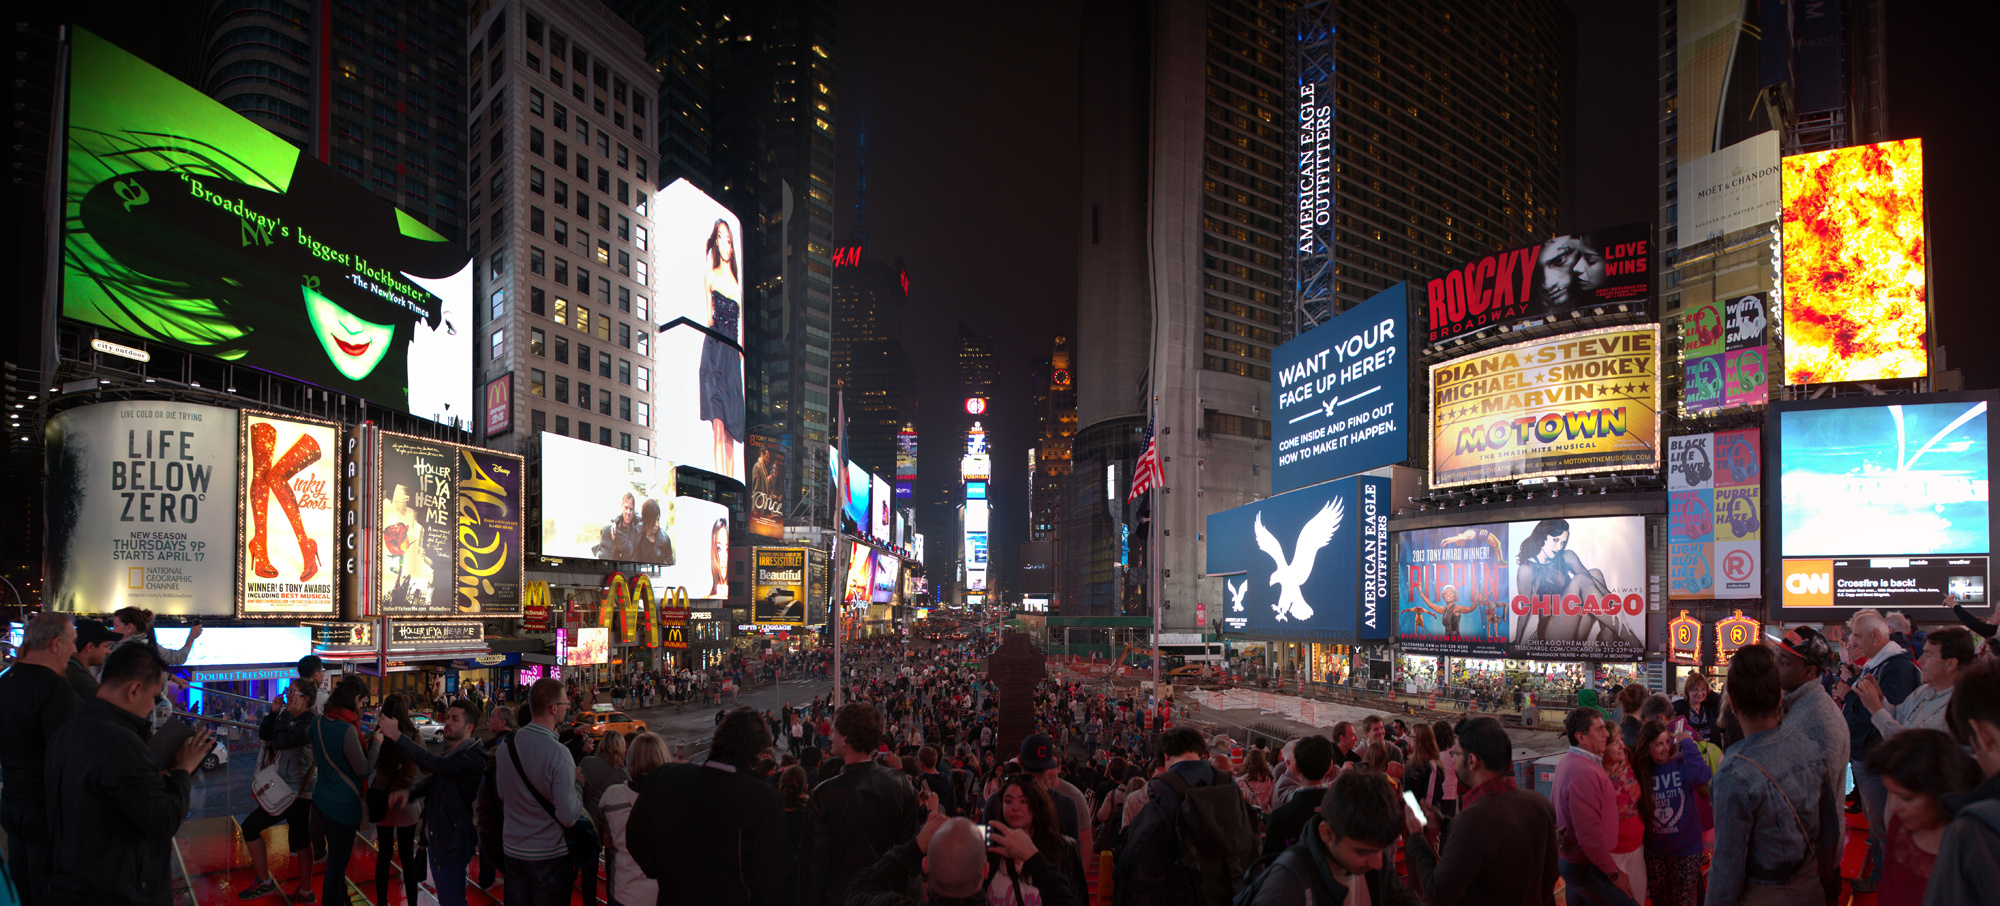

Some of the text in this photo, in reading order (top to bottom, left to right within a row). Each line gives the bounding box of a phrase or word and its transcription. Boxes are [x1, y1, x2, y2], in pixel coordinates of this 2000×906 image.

[1300, 83, 1315, 254] AMERICAN EAGLE
[1316, 105, 1331, 226] OUTFITTERS
[1732, 165, 1779, 187] CHANDON
[1695, 218, 1719, 228] SUCCESS
[1733, 206, 1754, 216] MATTER
[298, 226, 350, 267] biggest
[1605, 240, 1647, 260] LOVE
[832, 246, 862, 268] H&M
[1605, 257, 1647, 277] WINS
[352, 274, 368, 290] The
[407, 300, 430, 318] Times
[1428, 244, 1541, 331] ROCKY
[1430, 303, 1529, 341] BROADWAY
[97, 343, 146, 359] city outdoor
[1279, 318, 1395, 388] WANT YOUR
[1436, 334, 1651, 387] DIANA STEVIE
[1279, 346, 1396, 410] FACE UP HERE?
[1437, 357, 1651, 405] MICHAEL SMOKEY
[1482, 383, 1594, 414] MARVIN
[121, 410, 202, 422] LIVE COLD OR DIE TRYING
[490, 404, 506, 415] OPEN
[492, 411, 504, 425] 24
[488, 420, 508, 433] HOURS
[1279, 402, 1394, 451] COME INSIDE AND FIND OUT
[1455, 407, 1627, 456] MOTOWN
[129, 430, 194, 461] LIFE
[1279, 419, 1397, 467] HOW TO MAKE IT HAPPEN.
[1670, 438, 1707, 451] BLACK
[1715, 434, 1745, 446] BLUE
[1479, 442, 1597, 461] THE SMASH HITS MUSICAL
[1563, 454, 1651, 466] MOTOWNTHEMUSICAL.COM
[112, 461, 213, 493] BELOW
[413, 456, 451, 481] HOLLER
[420, 474, 450, 499] IF YA
[1671, 490, 1700, 502] PINK
[1716, 487, 1759, 500] PURPLE
[297, 493, 332, 510] Boots
[347, 437, 357, 574] PALACE
[415, 491, 447, 510] HEAR
[426, 507, 449, 526] ME
[1716, 512, 1748, 524] HAZE
[113, 539, 206, 552] THURSDAYS 9P
[131, 532, 187, 540] NEW SEASON
[113, 551, 205, 562] STARTS APRIL 17
[1365, 484, 1377, 629] AMERICAN EAGLE
[1377, 515, 1387, 598] OUTFITTERS
[1412, 546, 1490, 562] 2013 TONY AWARD WINNER!
[1671, 543, 1705, 555] LIGHT
[758, 556, 803, 567] IRRESISTIBLE!
[1671, 556, 1699, 566] BLUE
[146, 575, 193, 583] GEOGRAPHIC
[759, 569, 802, 580] Beautiful
[1406, 562, 1500, 603] PIPPIN
[1785, 573, 1830, 594] CNN
[1837, 578, 1916, 588] Crossfire is back!
[247, 583, 331, 594] WINNER! 6 TONY AWARDS
[1511, 593, 1644, 616] CHICAGO
[399, 626, 425, 636] HOLLER
[1401, 633, 1507, 643] PIPPINTHEMUSICAL.COM
[1515, 645, 1593, 653] TELECHARGE.COM/CHICAGO
[1528, 660, 1566, 674] SLAM
